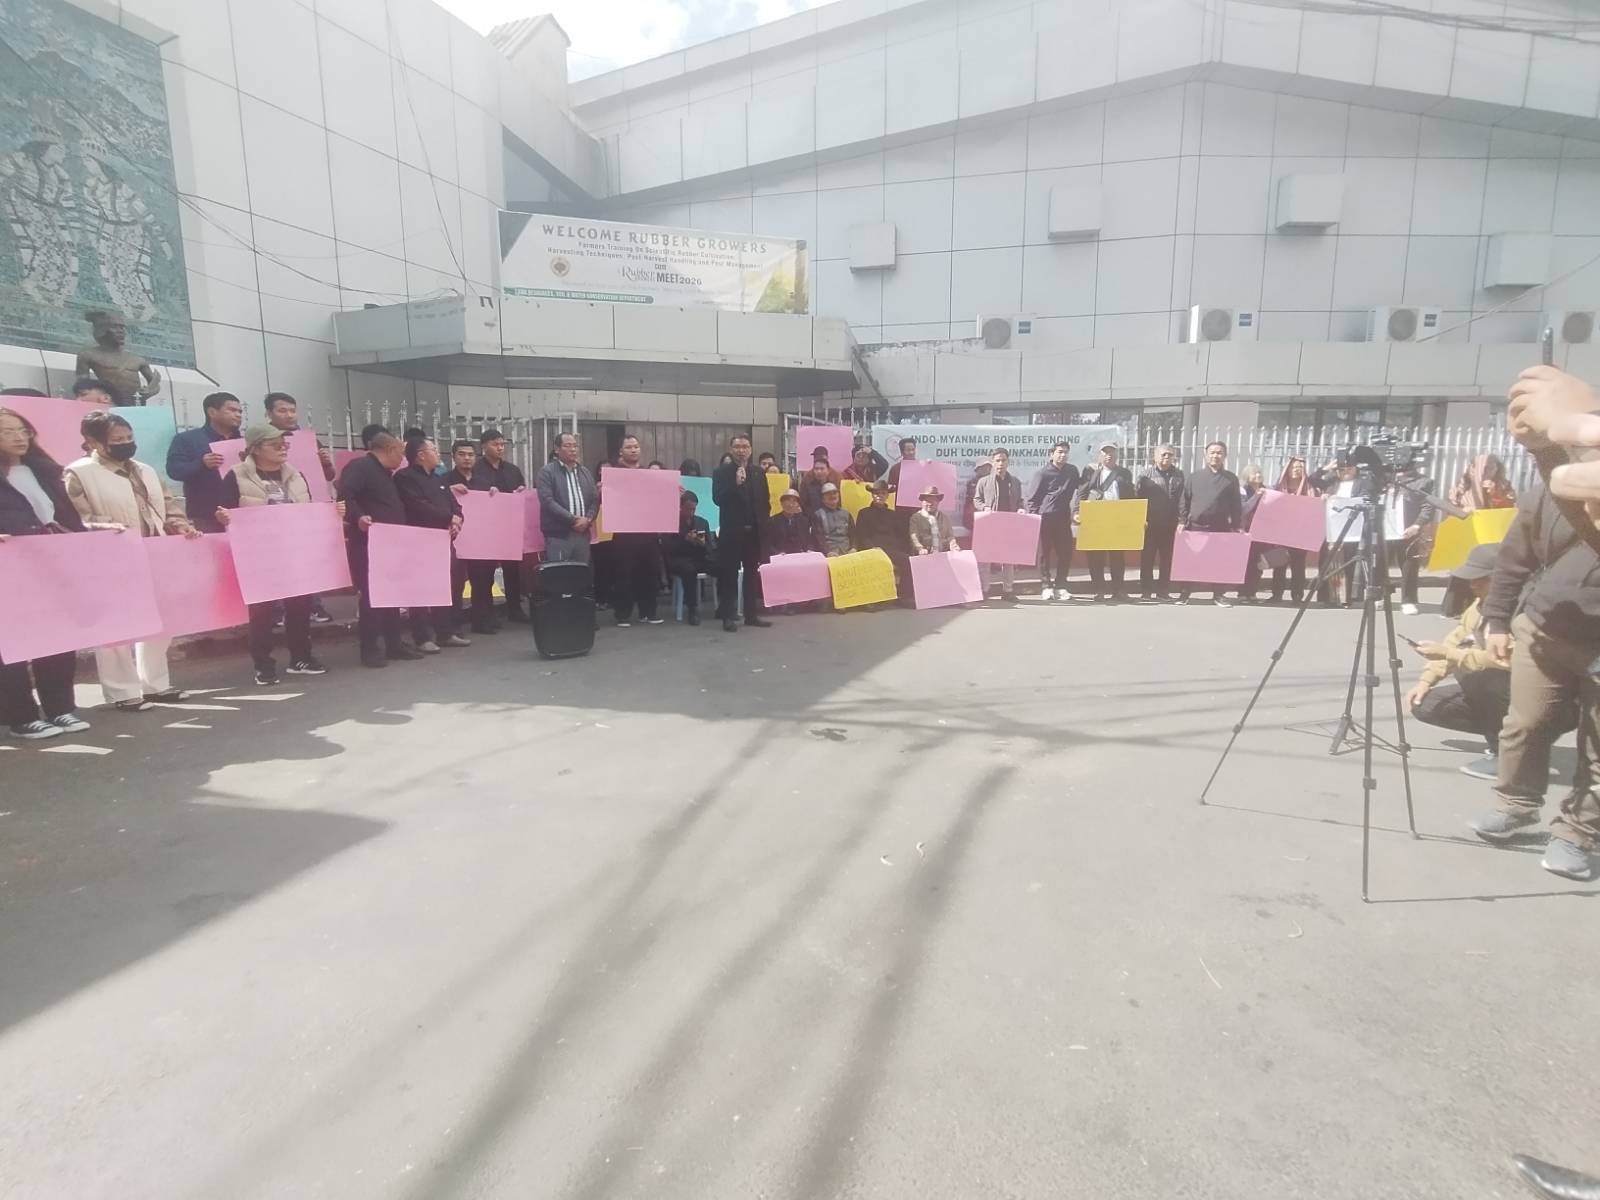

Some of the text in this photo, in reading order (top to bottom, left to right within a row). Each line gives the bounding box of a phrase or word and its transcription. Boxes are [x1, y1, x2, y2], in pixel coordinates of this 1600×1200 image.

[542, 224, 767, 254] WELCOME RUBBER GROWERS
[608, 243, 634, 253] Training
[547, 246, 585, 257] Harvesting
[643, 254, 668, 263] Harvest
[911, 435, 1080, 443] INDO-MYANMAR BORDER FENCING
[936, 448, 958, 457] DUH
[1008, 448, 1051, 457] INKHAW
